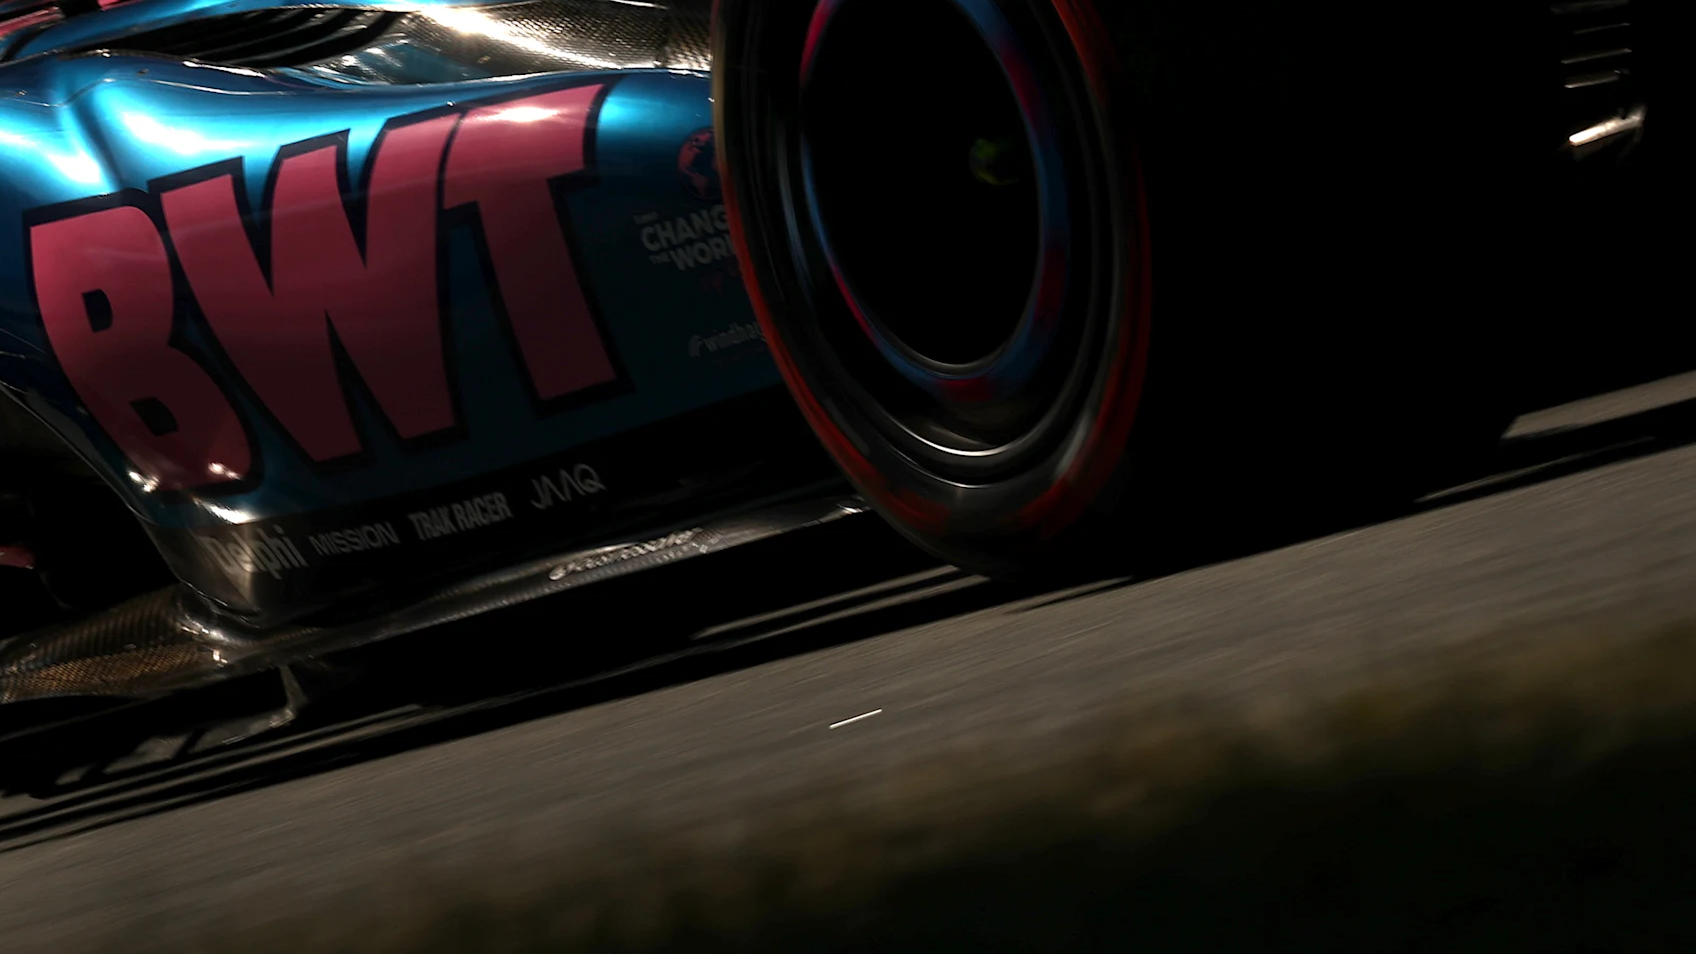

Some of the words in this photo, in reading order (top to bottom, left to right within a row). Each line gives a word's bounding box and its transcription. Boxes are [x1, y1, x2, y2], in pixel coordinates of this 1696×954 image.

[640, 204, 729, 252] CHANG
[24, 81, 629, 494] BWT
[308, 520, 399, 557] MISSION
[407, 505, 457, 541] TRAK
[454, 491, 514, 535] RACER
